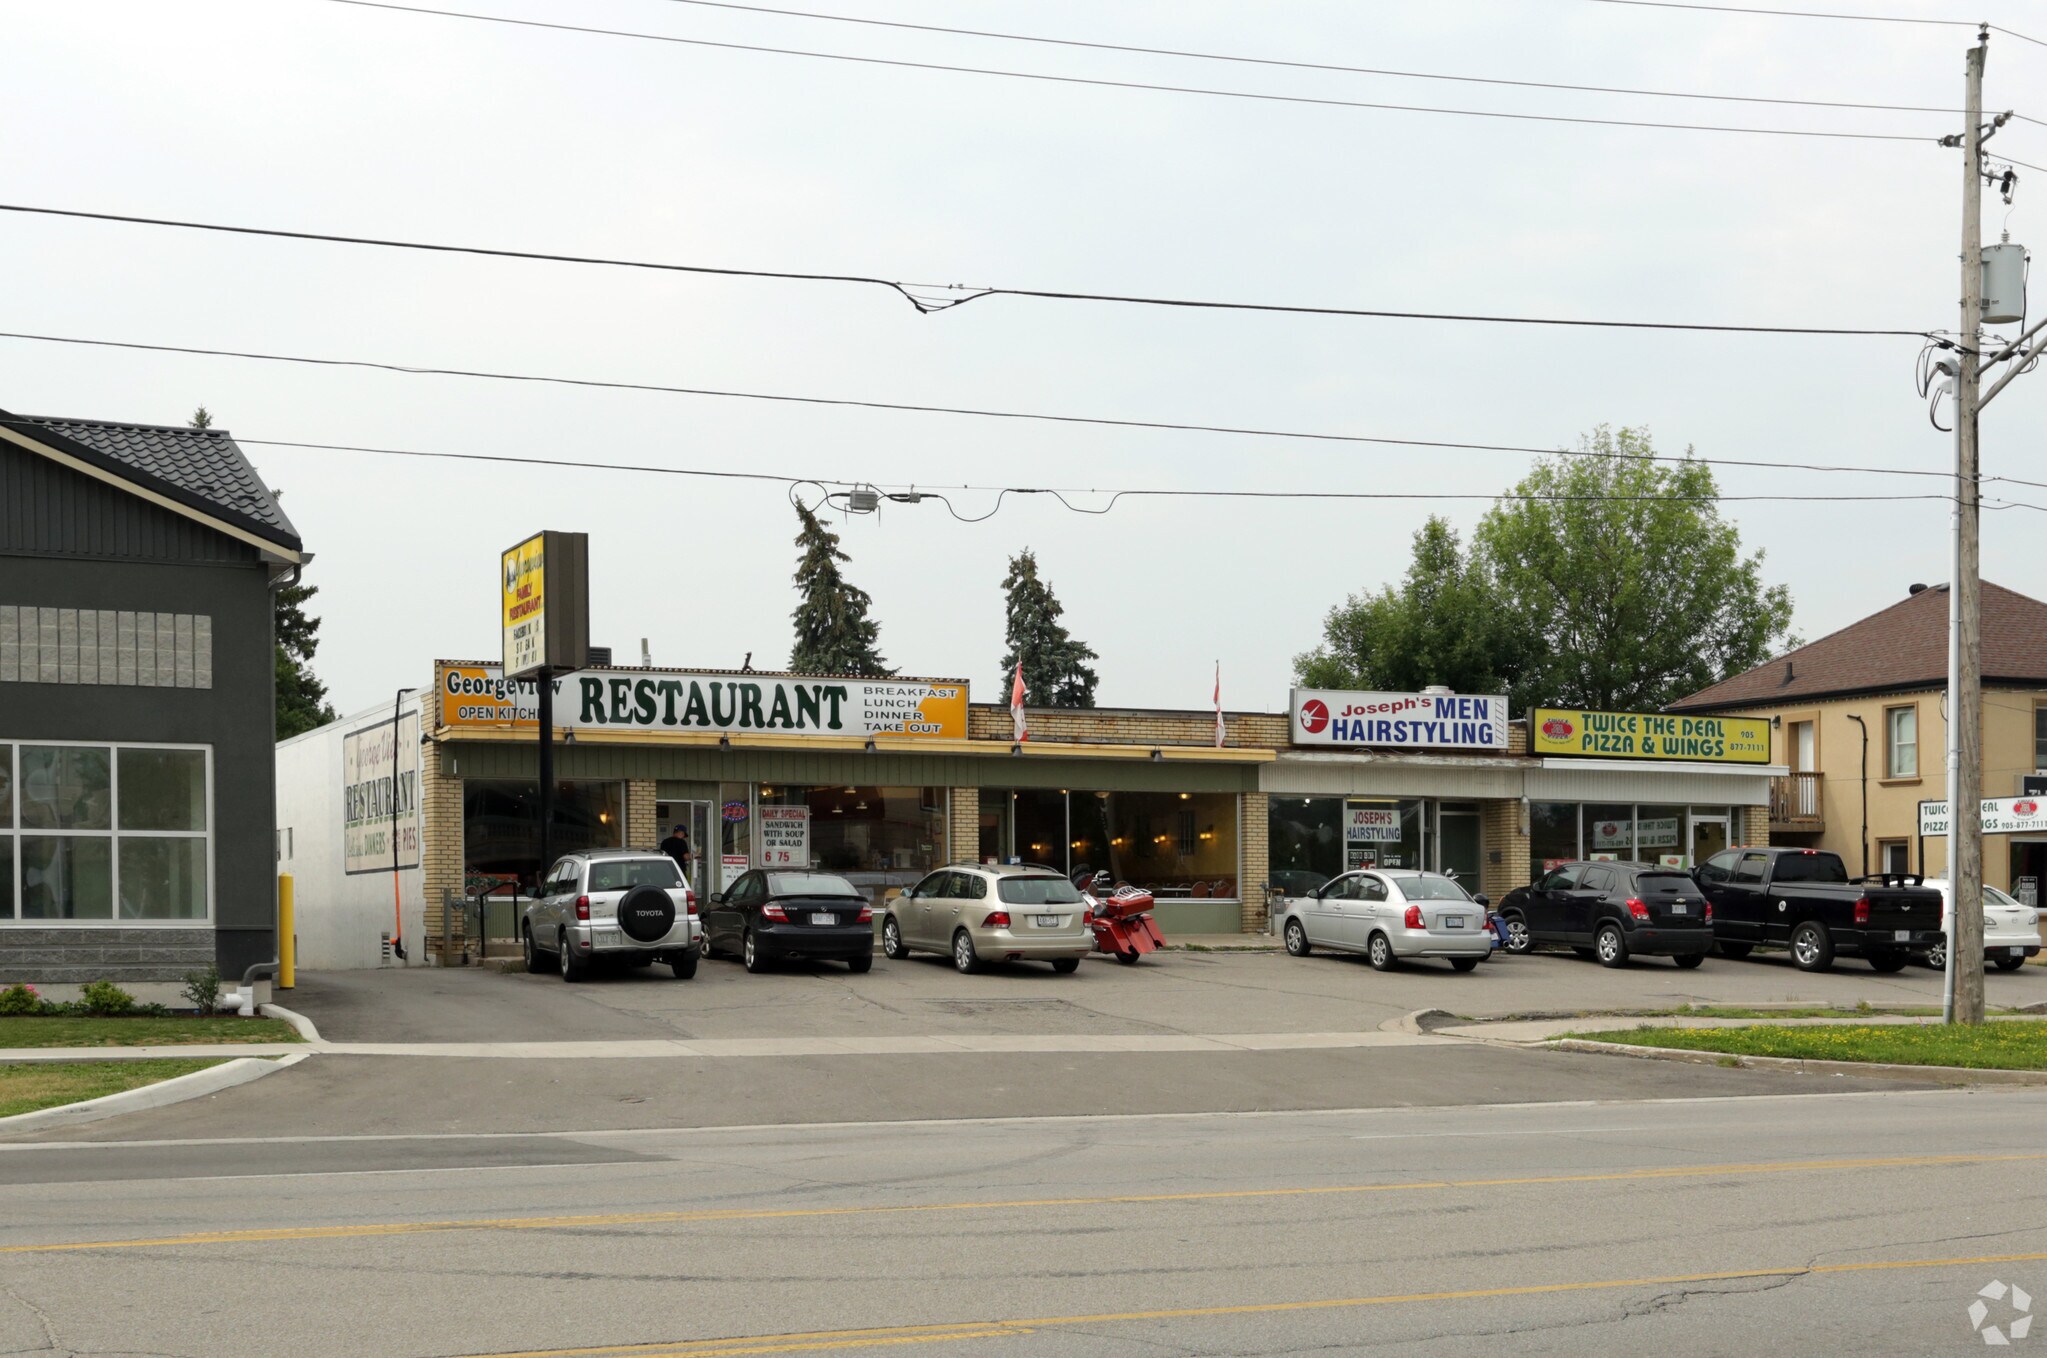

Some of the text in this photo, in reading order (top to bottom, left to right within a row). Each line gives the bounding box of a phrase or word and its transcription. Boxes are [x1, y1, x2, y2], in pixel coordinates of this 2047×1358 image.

[517, 582, 533, 602] FAMILY
[509, 595, 541, 622] RESTAURANT
[447, 672, 562, 700] Georgeviw
[864, 687, 957, 697] BREAKFAST
[579, 677, 848, 729] RESTAURANT
[864, 699, 917, 708] LUNCH
[1340, 697, 1488, 720] Joseph's MEN
[458, 707, 540, 720] OPEN KITCH
[864, 711, 923, 720] DINNER
[864, 723, 941, 733] TAKE OUT
[1331, 718, 1493, 745] HAIRSTYLING
[1581, 713, 1637, 733] TWICE
[1643, 717, 1675, 736] THE
[1682, 719, 1725, 738] DEAL
[1582, 733, 1634, 753] PIZZA
[1641, 737, 1656, 754] &
[1662, 738, 1725, 757] WINGS
[1730, 743, 1765, 751] 877-7111
[346, 770, 415, 823] RESTAURANT
[721, 806, 748, 817] OPEN
[762, 809, 806, 818] DAILY SPECIAL
[1981, 802, 1999, 812] EAL
[1353, 811, 1392, 824] JOSEPH'S
[403, 827, 416, 851] PIES
[764, 830, 804, 838] WITH SOUP
[1347, 827, 1400, 840] HAIRSTYLING
[364, 831, 385, 856] DINNERS
[765, 851, 789, 862] 6 75
